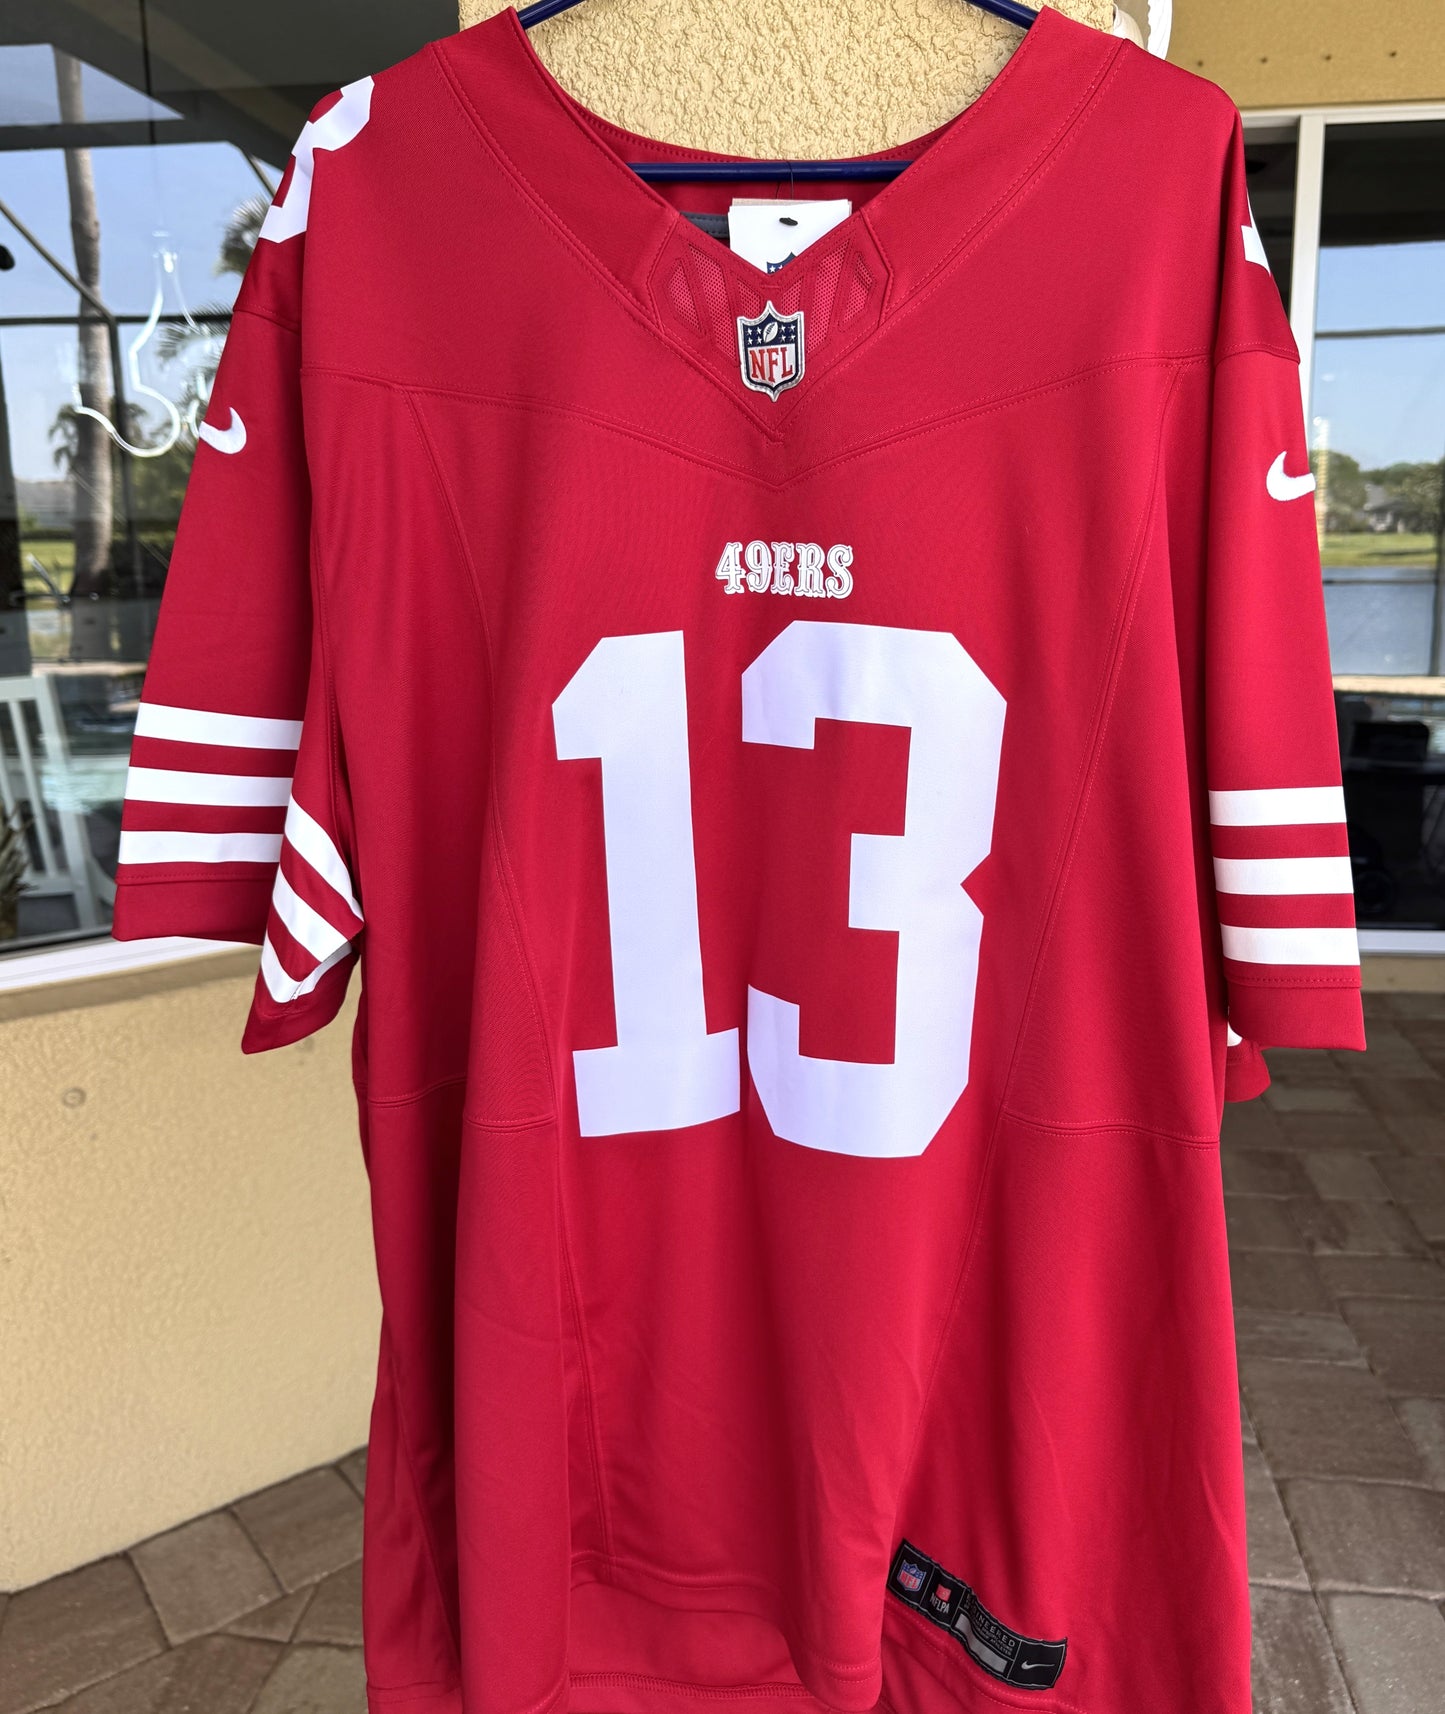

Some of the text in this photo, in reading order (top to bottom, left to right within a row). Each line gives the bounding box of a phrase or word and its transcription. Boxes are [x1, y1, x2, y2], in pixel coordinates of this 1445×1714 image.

[748, 346, 793, 384] NFL
[714, 541, 854, 599] 49ERS
[552, 620, 1007, 1157] 13
[899, 1570, 919, 1589] NFL
[930, 1592, 950, 1614] NFLPA
